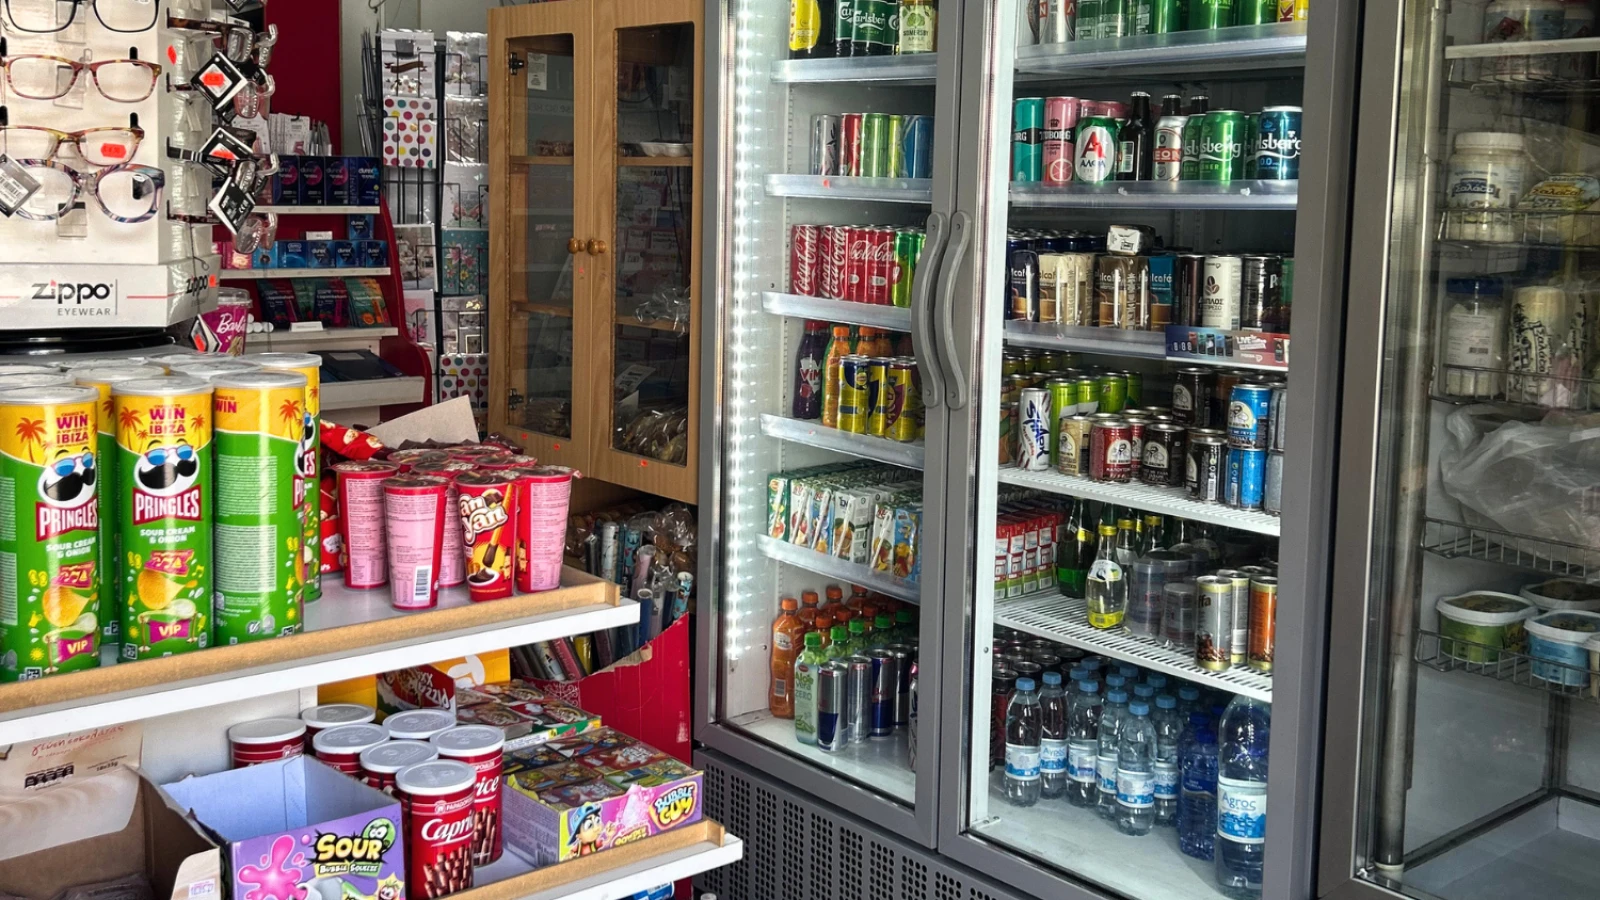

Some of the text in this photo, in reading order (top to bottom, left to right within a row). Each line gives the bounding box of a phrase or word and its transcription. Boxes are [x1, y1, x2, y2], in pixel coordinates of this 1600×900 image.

[1151, 273, 1173, 283] lcafé
[57, 307, 111, 316] EYEWEAR
[149, 407, 186, 420] WIN
[56, 414, 88, 429] WIN
[149, 424, 186, 434] IBIZA
[56, 432, 88, 444] IBIZA
[135, 489, 200, 521] PRINGLES
[460, 494, 484, 517] an
[39, 498, 98, 537] PRINGLES
[166, 526, 196, 535] CREAM
[158, 535, 188, 544] ONION
[46, 543, 72, 552] SOUR
[158, 625, 182, 637] VIP
[66, 640, 89, 654] VIP
[475, 775, 500, 796] rice
[655, 786, 694, 813] BUBBLE
[1221, 791, 1257, 811] Agros
[660, 797, 693, 825] GUM
[421, 809, 474, 843] Capri
[316, 833, 383, 861] SOUR
[320, 864, 348, 874] BUBBLE
